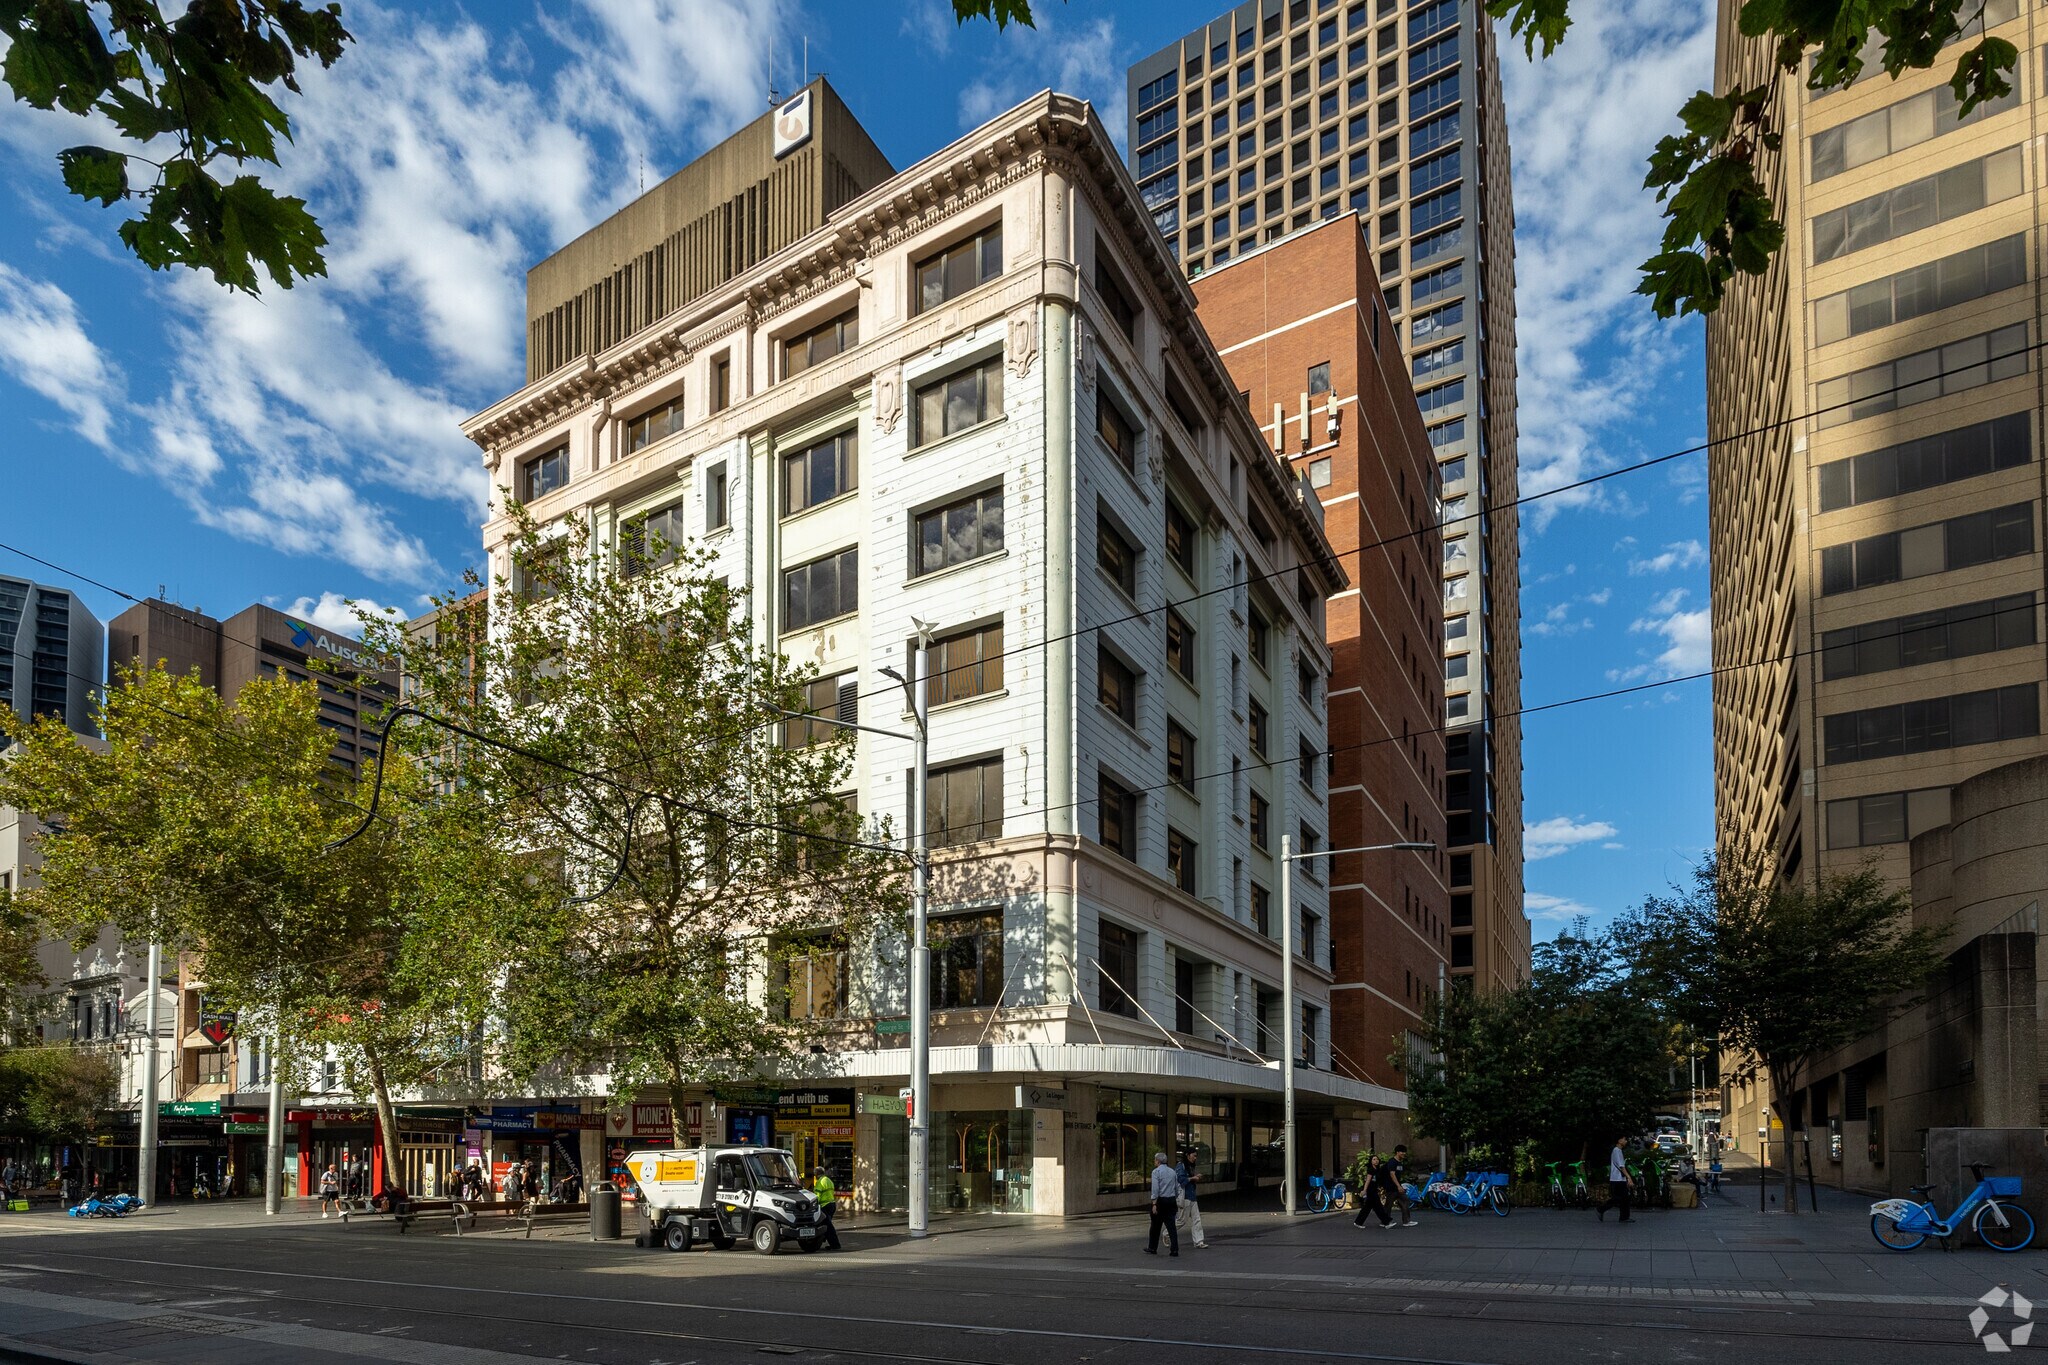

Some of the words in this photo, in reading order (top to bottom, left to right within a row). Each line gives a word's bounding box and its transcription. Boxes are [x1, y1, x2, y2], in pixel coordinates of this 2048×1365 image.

[877, 1024, 897, 1032] George
[778, 1093, 795, 1105] end
[796, 1092, 816, 1104] with
[818, 1094, 829, 1103] us
[556, 1114, 581, 1124] MONEY
[588, 1116, 604, 1126] LENT
[636, 1106, 671, 1125] MONEY
[685, 1106, 701, 1125] NT
[493, 1121, 532, 1129] PHARMACY
[821, 1127, 838, 1135] MONEY
[839, 1127, 852, 1135] LENT
[553, 1140, 581, 1177] PHARMACY
